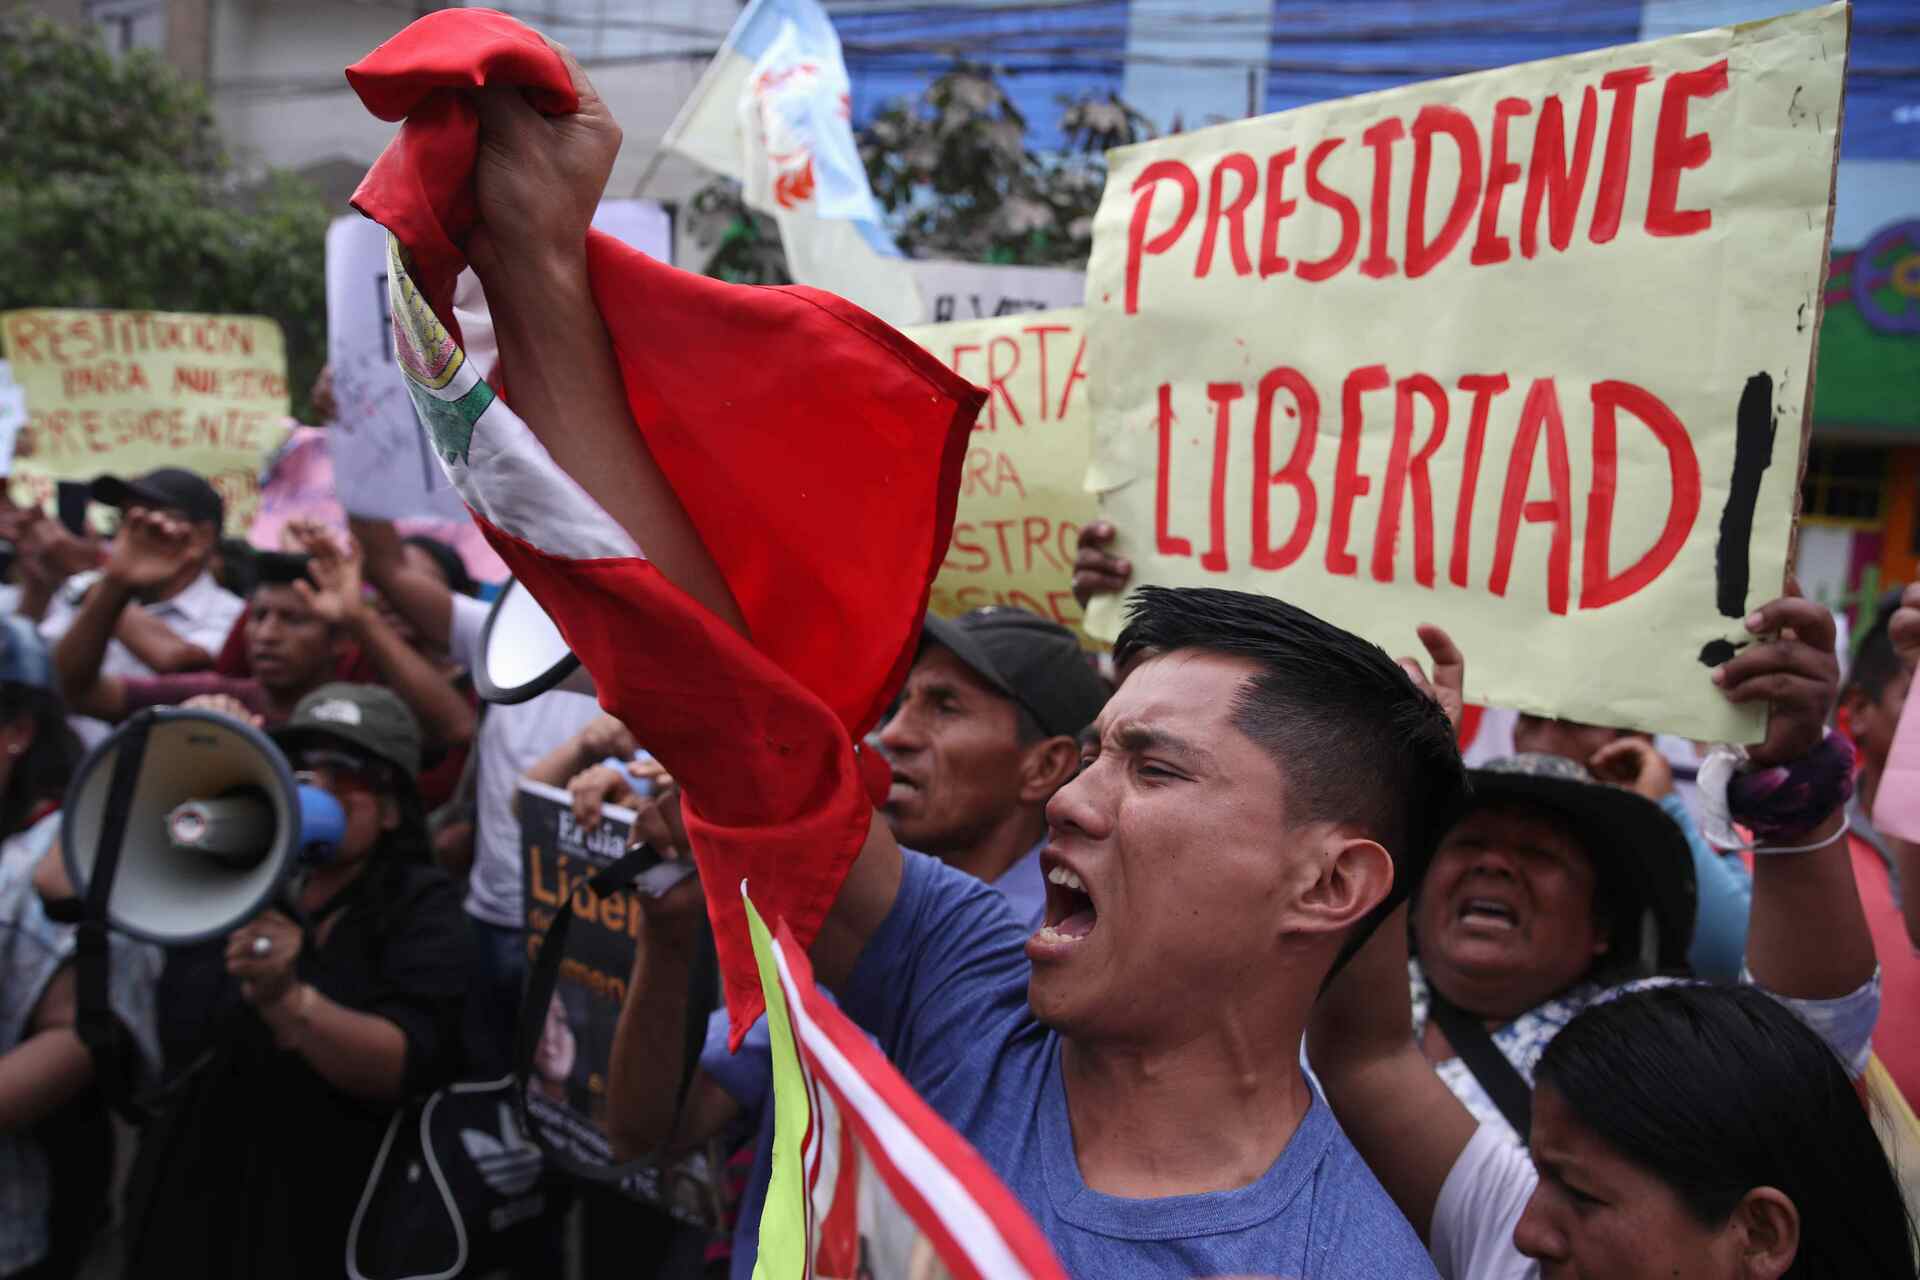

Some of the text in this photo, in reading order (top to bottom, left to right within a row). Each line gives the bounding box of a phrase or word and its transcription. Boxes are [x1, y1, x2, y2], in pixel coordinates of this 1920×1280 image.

[1123, 58, 1730, 315] PRESIDENTE
[962, 447, 1028, 500] RA
[942, 516, 1080, 576] STRO
